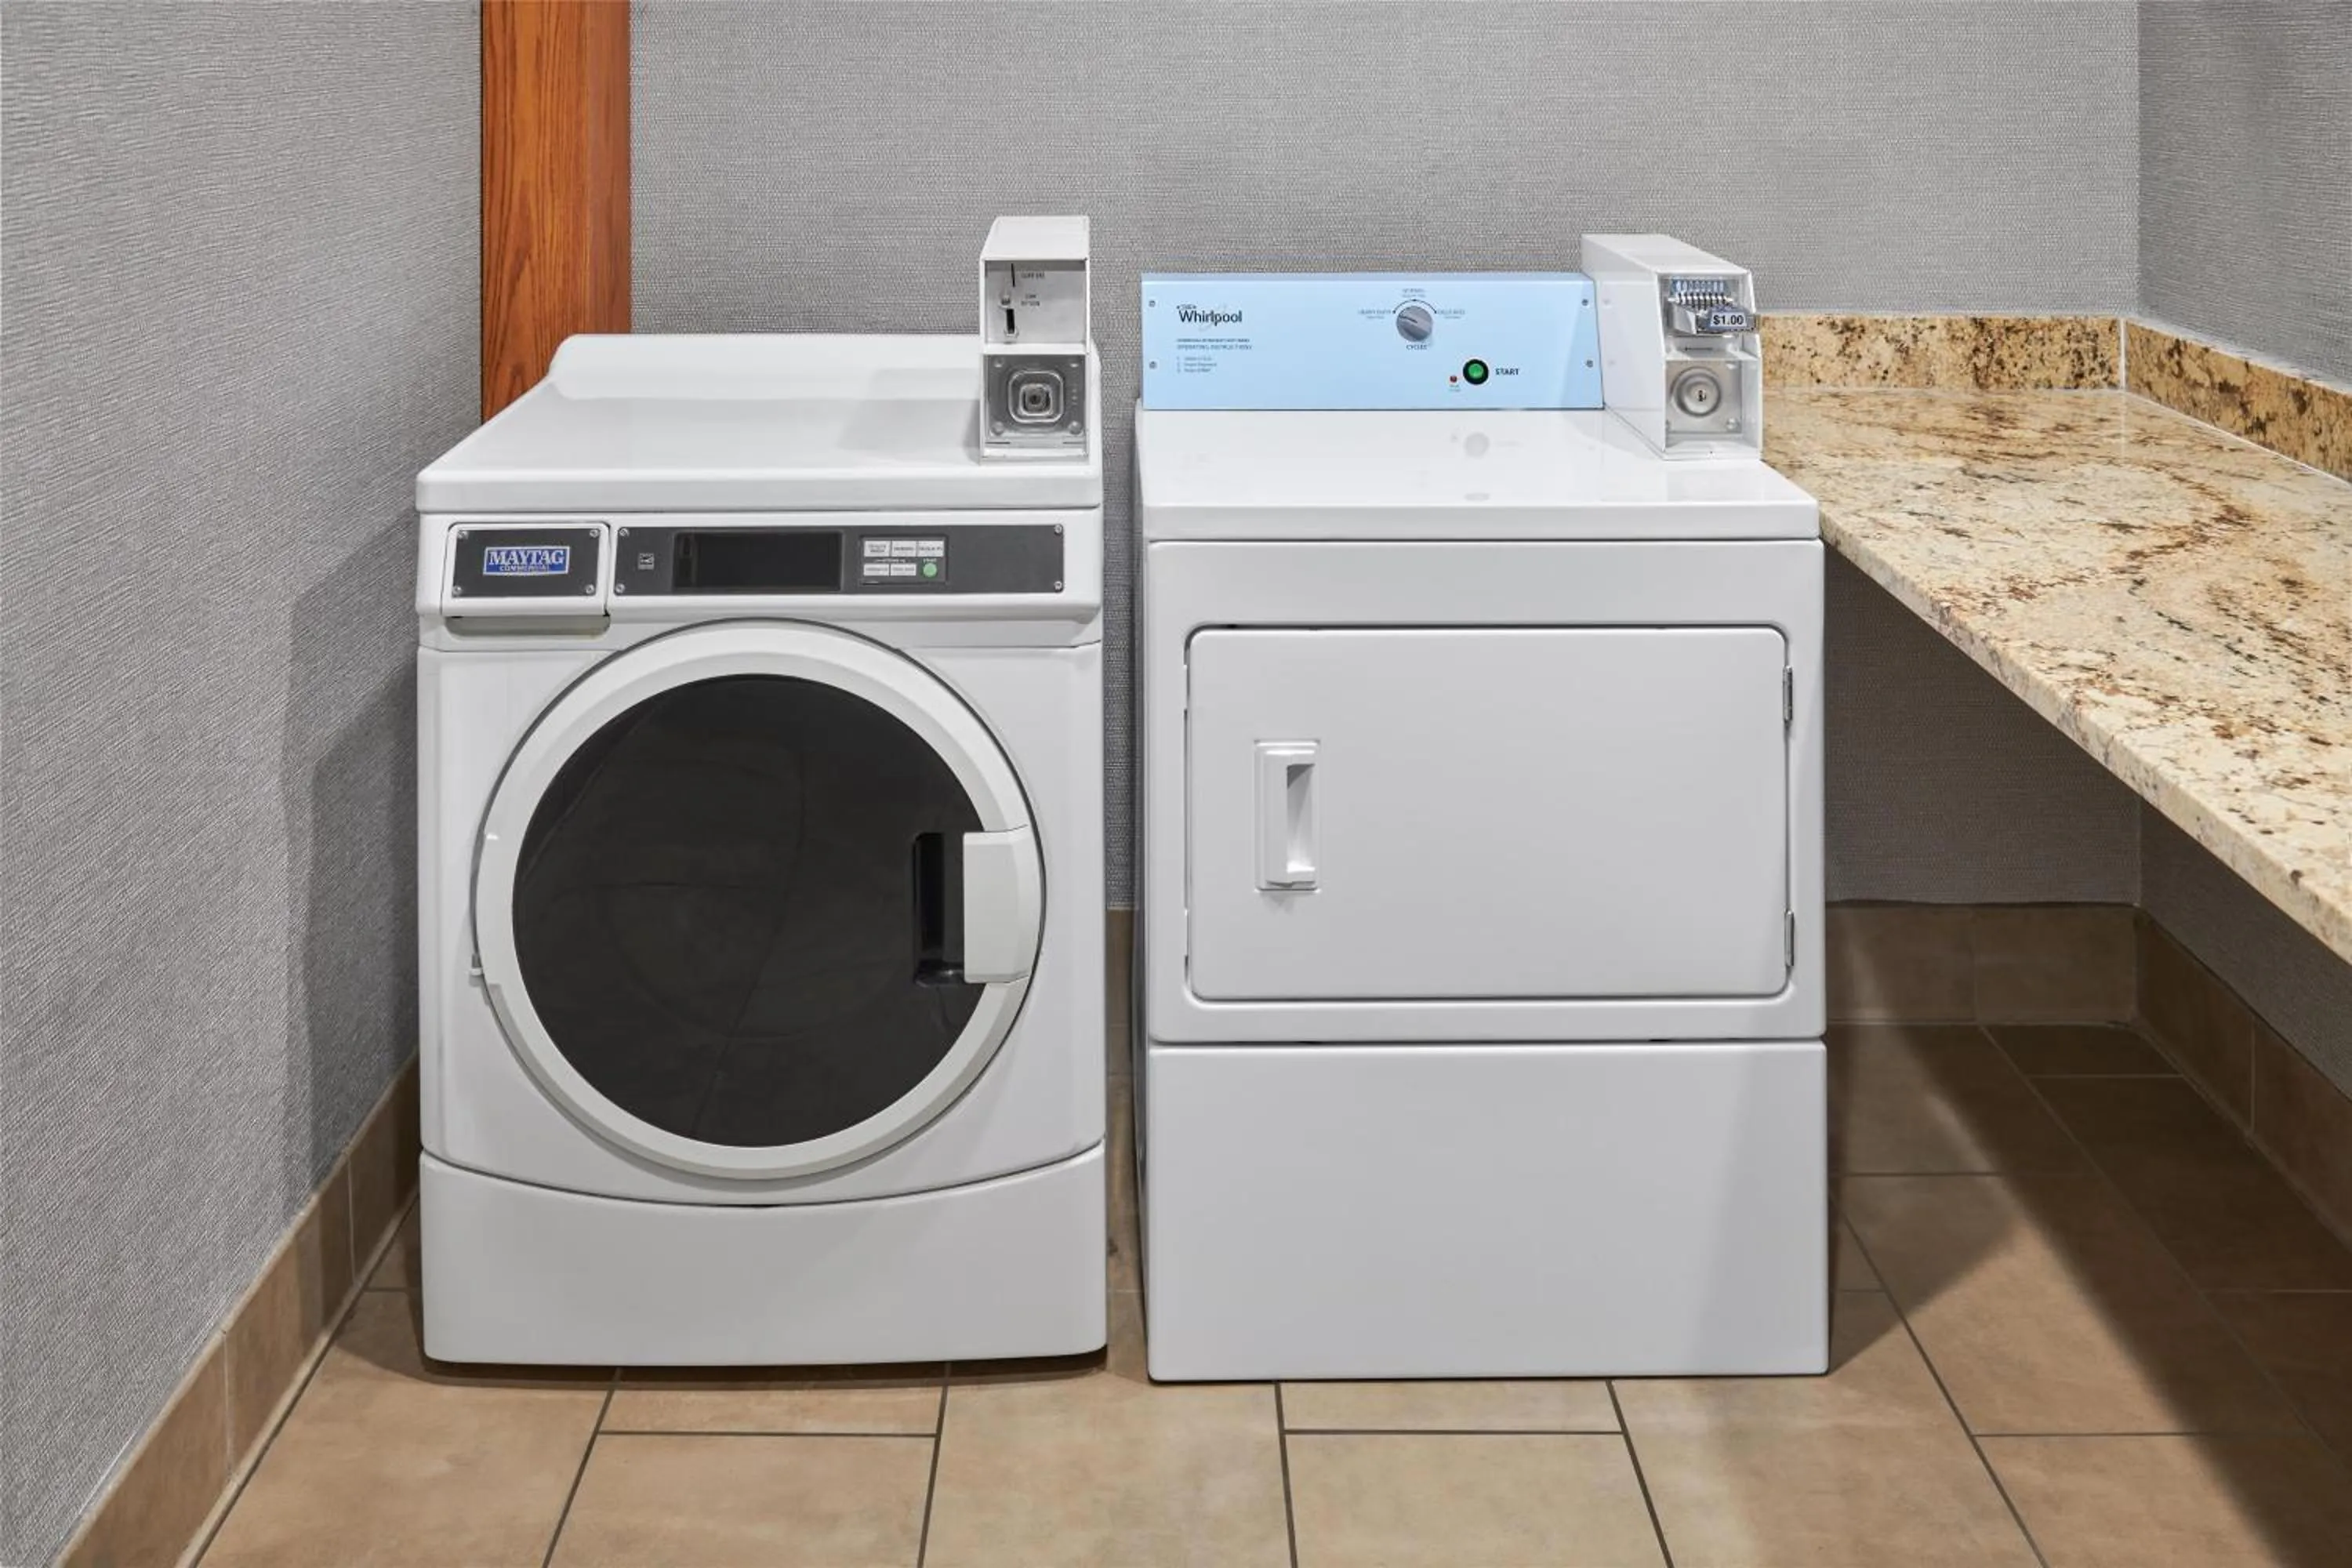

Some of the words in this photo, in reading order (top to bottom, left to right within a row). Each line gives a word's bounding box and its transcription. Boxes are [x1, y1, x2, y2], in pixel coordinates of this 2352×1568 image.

[1178, 310, 1242, 326] Whirlpool
[1713, 314, 1744, 325] $1.00
[489, 549, 564, 565] MAYTAG
